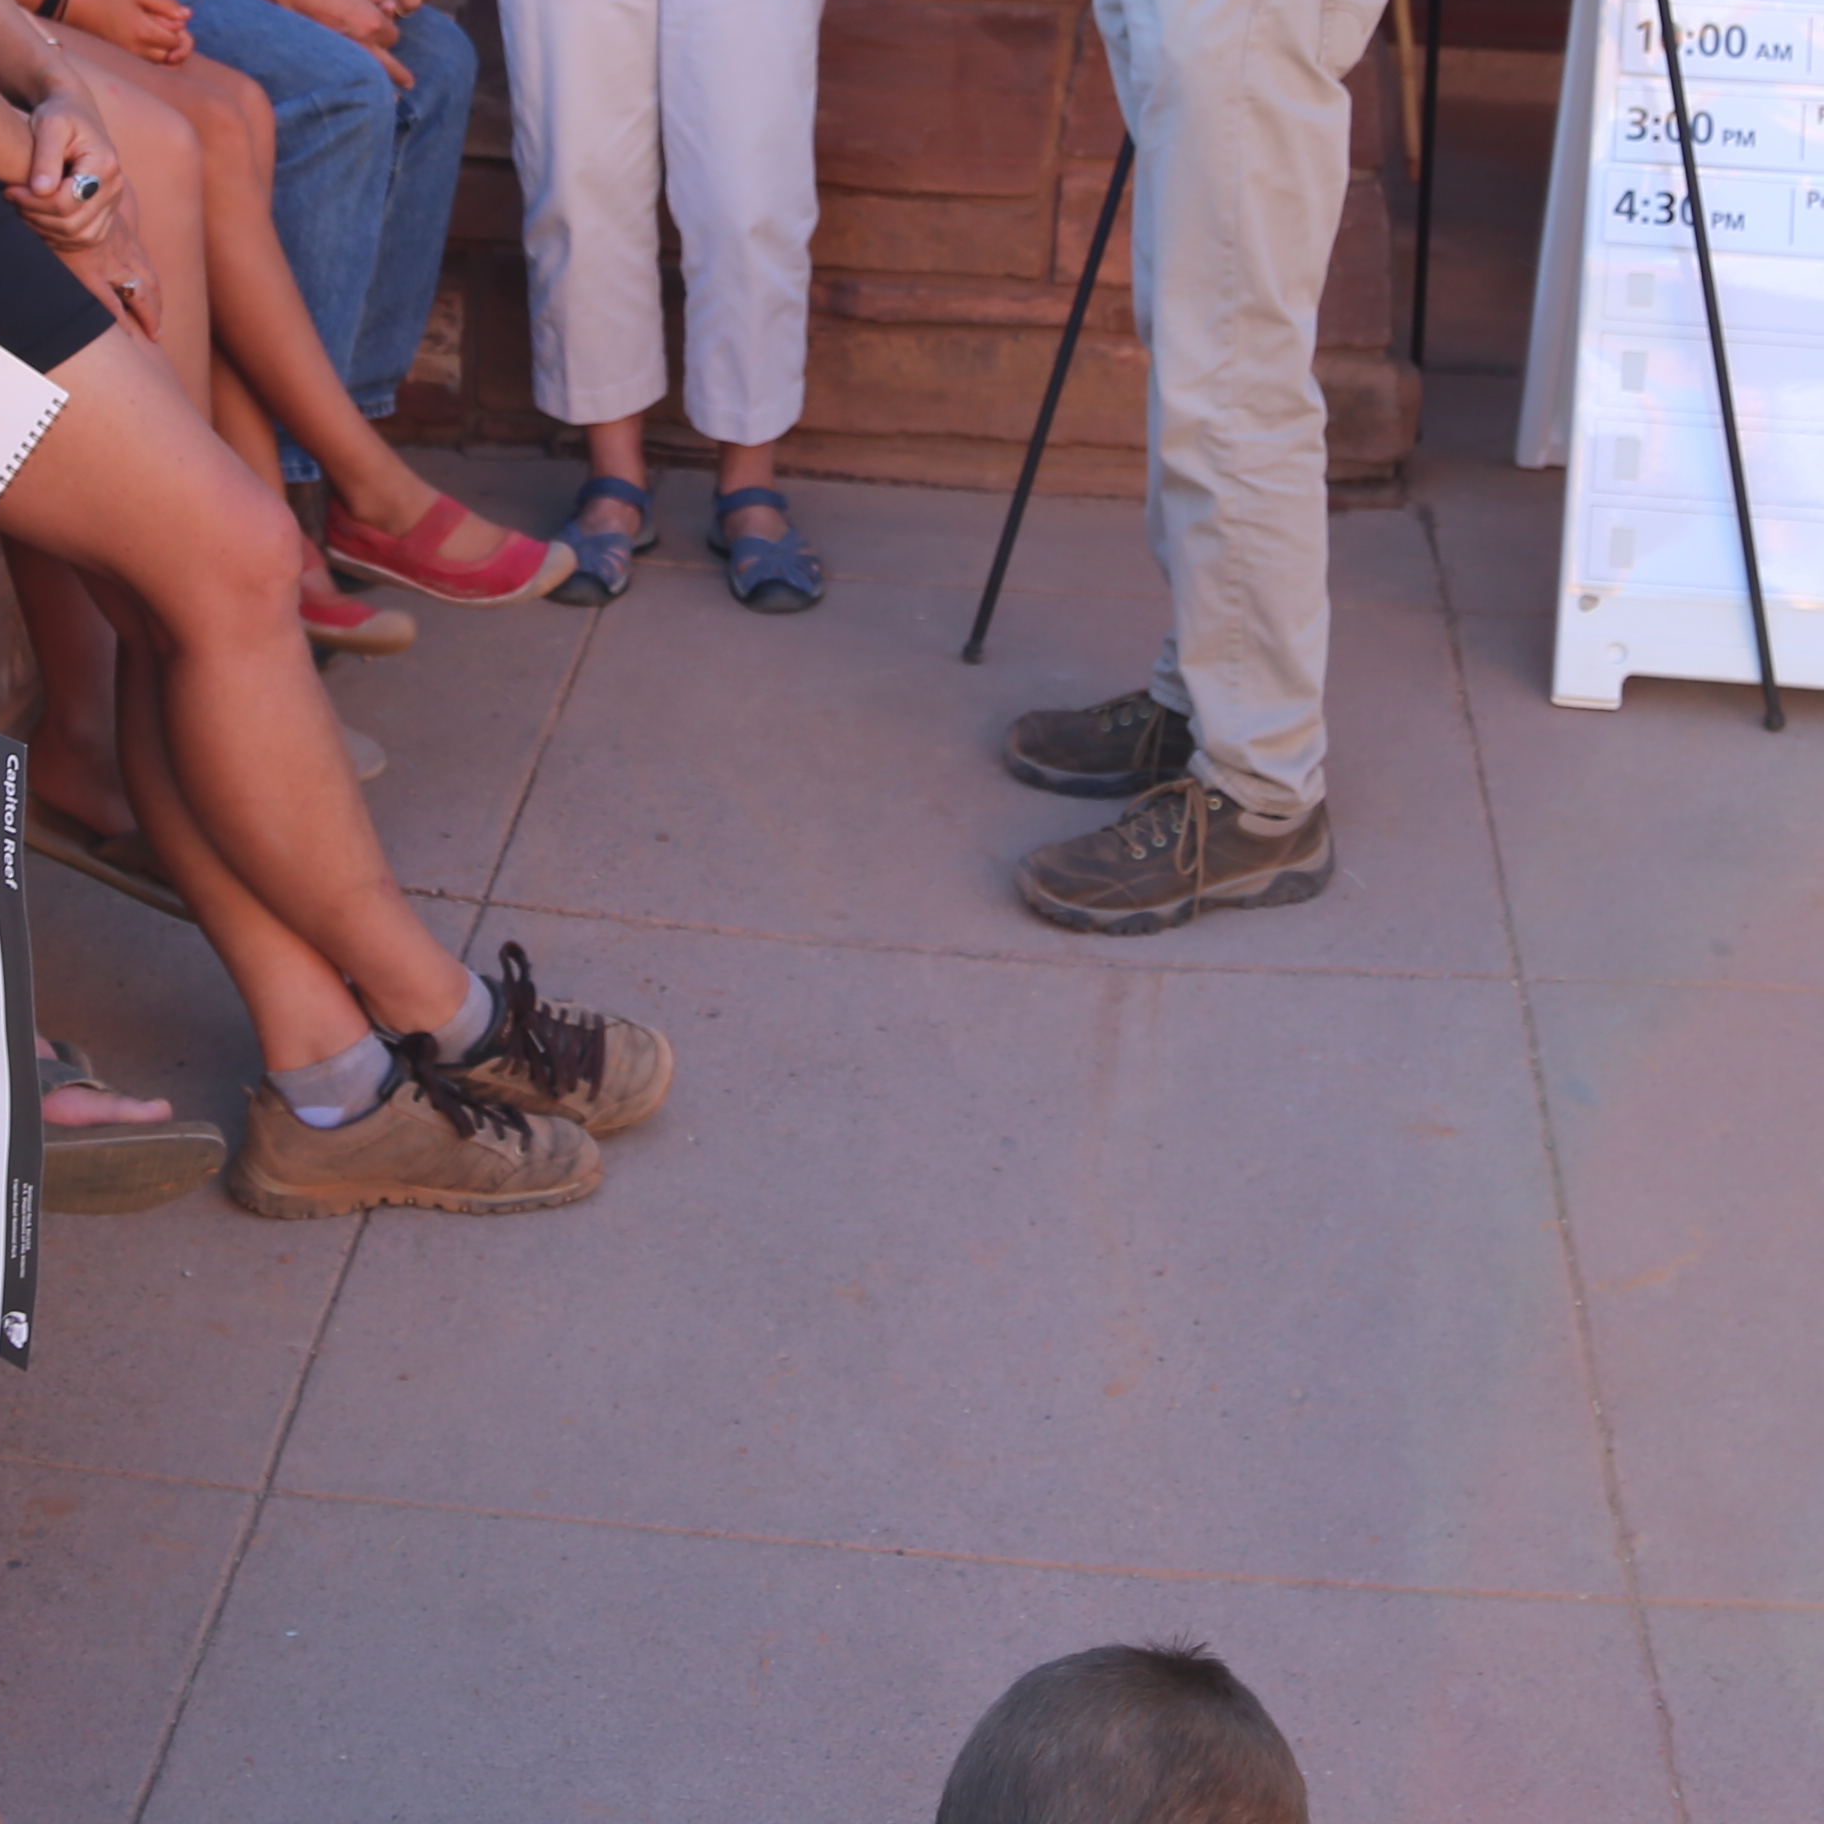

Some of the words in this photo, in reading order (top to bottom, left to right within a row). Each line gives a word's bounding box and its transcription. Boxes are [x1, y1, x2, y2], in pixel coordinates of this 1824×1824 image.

[1755, 43, 1793, 62] AM
[1625, 106, 1714, 145] 3:00
[1722, 128, 1756, 148] PM
[1711, 212, 1745, 231] PM
[3, 753, 20, 834] Capitol
[2, 838, 19, 890] Reef
